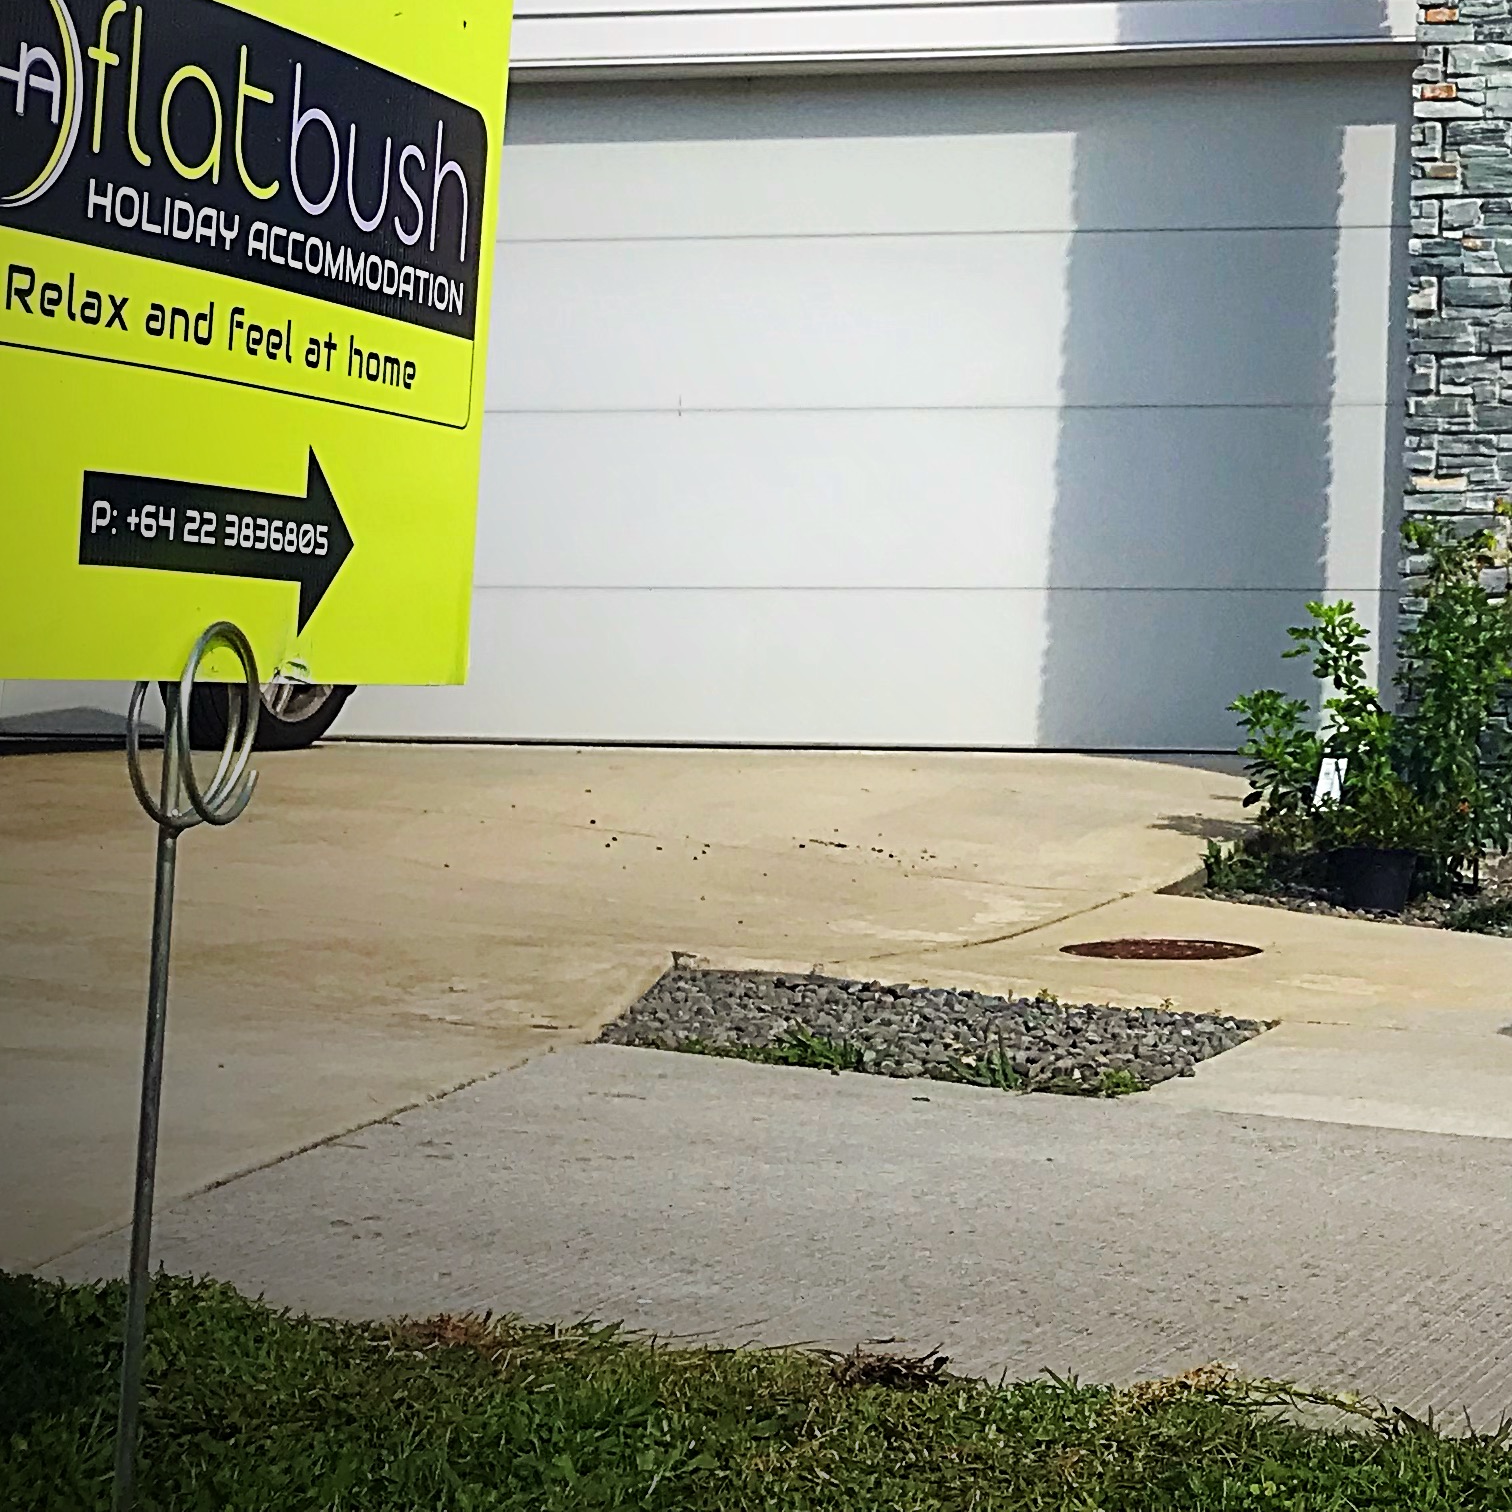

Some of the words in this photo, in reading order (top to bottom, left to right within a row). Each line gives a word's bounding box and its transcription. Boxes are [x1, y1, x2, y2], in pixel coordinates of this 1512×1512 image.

[87, 178, 240, 251] HOLIDAY
[247, 220, 464, 316] ACCOMMODATION
[5, 263, 130, 332] Relax
[145, 301, 215, 346] and
[304, 331, 338, 372] at
[347, 334, 417, 390] home
[90, 500, 118, 535] P:
[126, 504, 176, 541] +64
[183, 509, 217, 545] 22
[224, 513, 329, 556] 3836805
